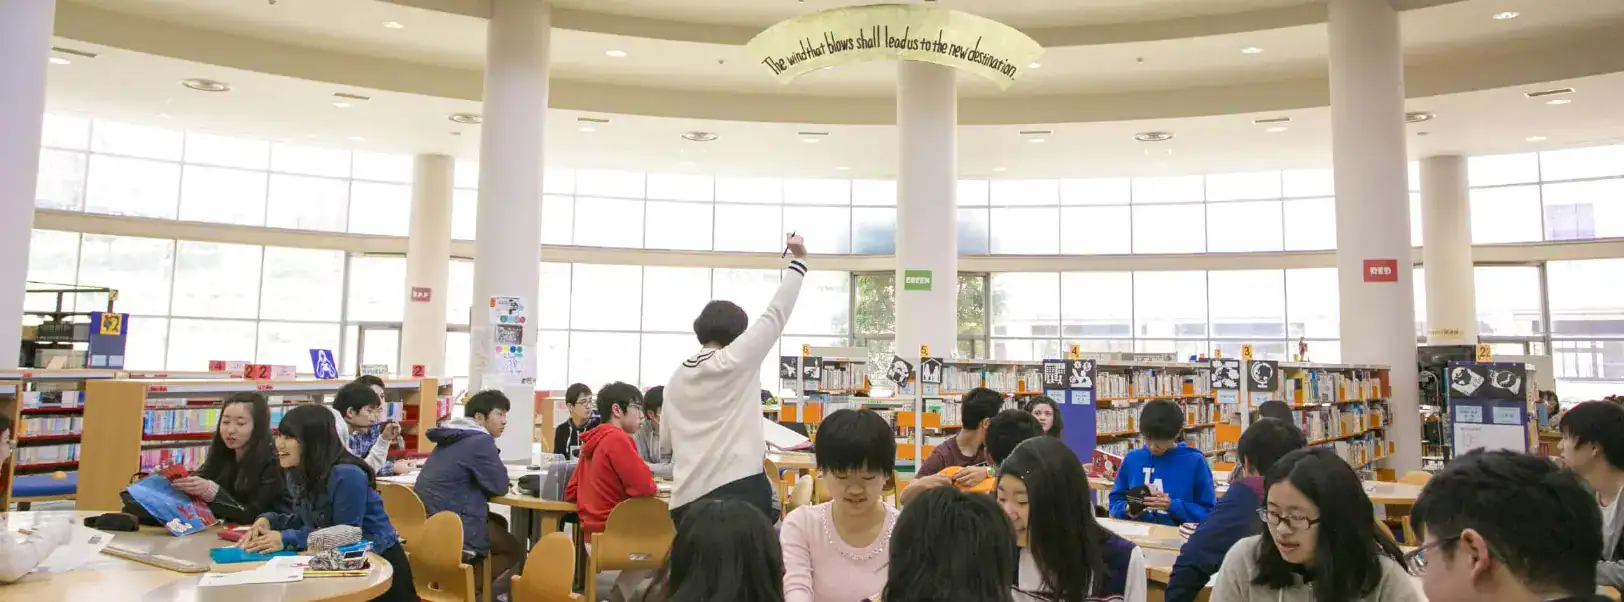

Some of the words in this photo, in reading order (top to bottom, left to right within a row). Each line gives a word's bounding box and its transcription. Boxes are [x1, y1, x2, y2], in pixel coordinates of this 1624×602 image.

[761, 56, 788, 76] The
[786, 40, 808, 65] wind
[806, 37, 826, 59] that
[823, 31, 855, 55] blows
[856, 25, 881, 49] shall
[885, 25, 910, 49] lead
[906, 38, 919, 50] us
[919, 38, 932, 51] to
[932, 29, 948, 55] the
[948, 43, 970, 60] new
[967, 36, 1017, 81] destination.
[414, 365, 422, 376] 2
